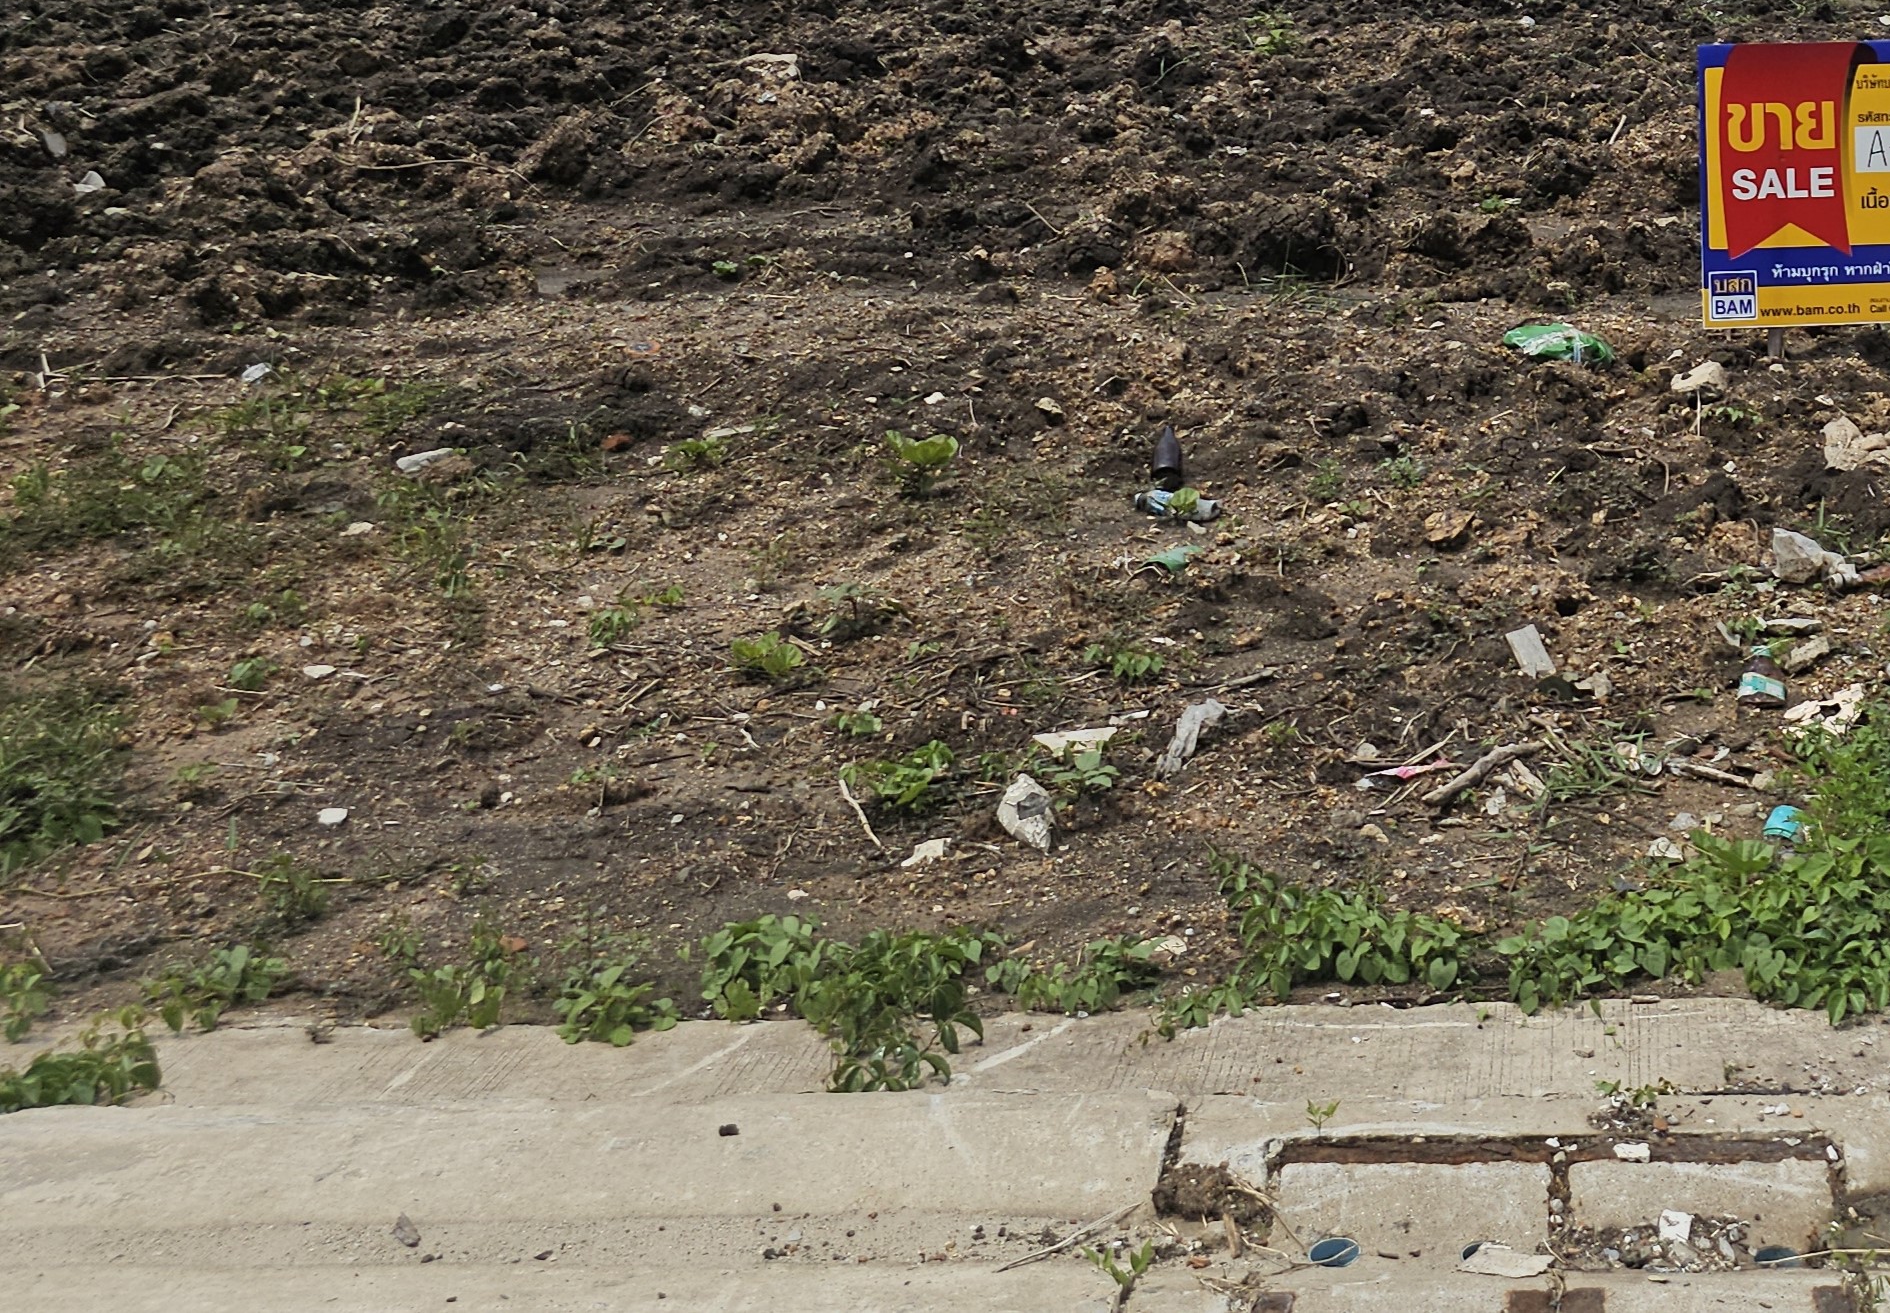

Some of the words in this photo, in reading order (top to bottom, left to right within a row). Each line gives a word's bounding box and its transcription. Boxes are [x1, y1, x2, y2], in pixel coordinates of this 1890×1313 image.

[1727, 101, 1836, 152] ขาย
[1732, 167, 1835, 200] SALE
[1772, 263, 1838, 282] ห้ามบุกรุก
[1714, 277, 1752, 294] บสก
[1715, 300, 1752, 315] BAM
[1760, 303, 1860, 317] www.bam.co.th
[1870, 304, 1887, 313] Call
